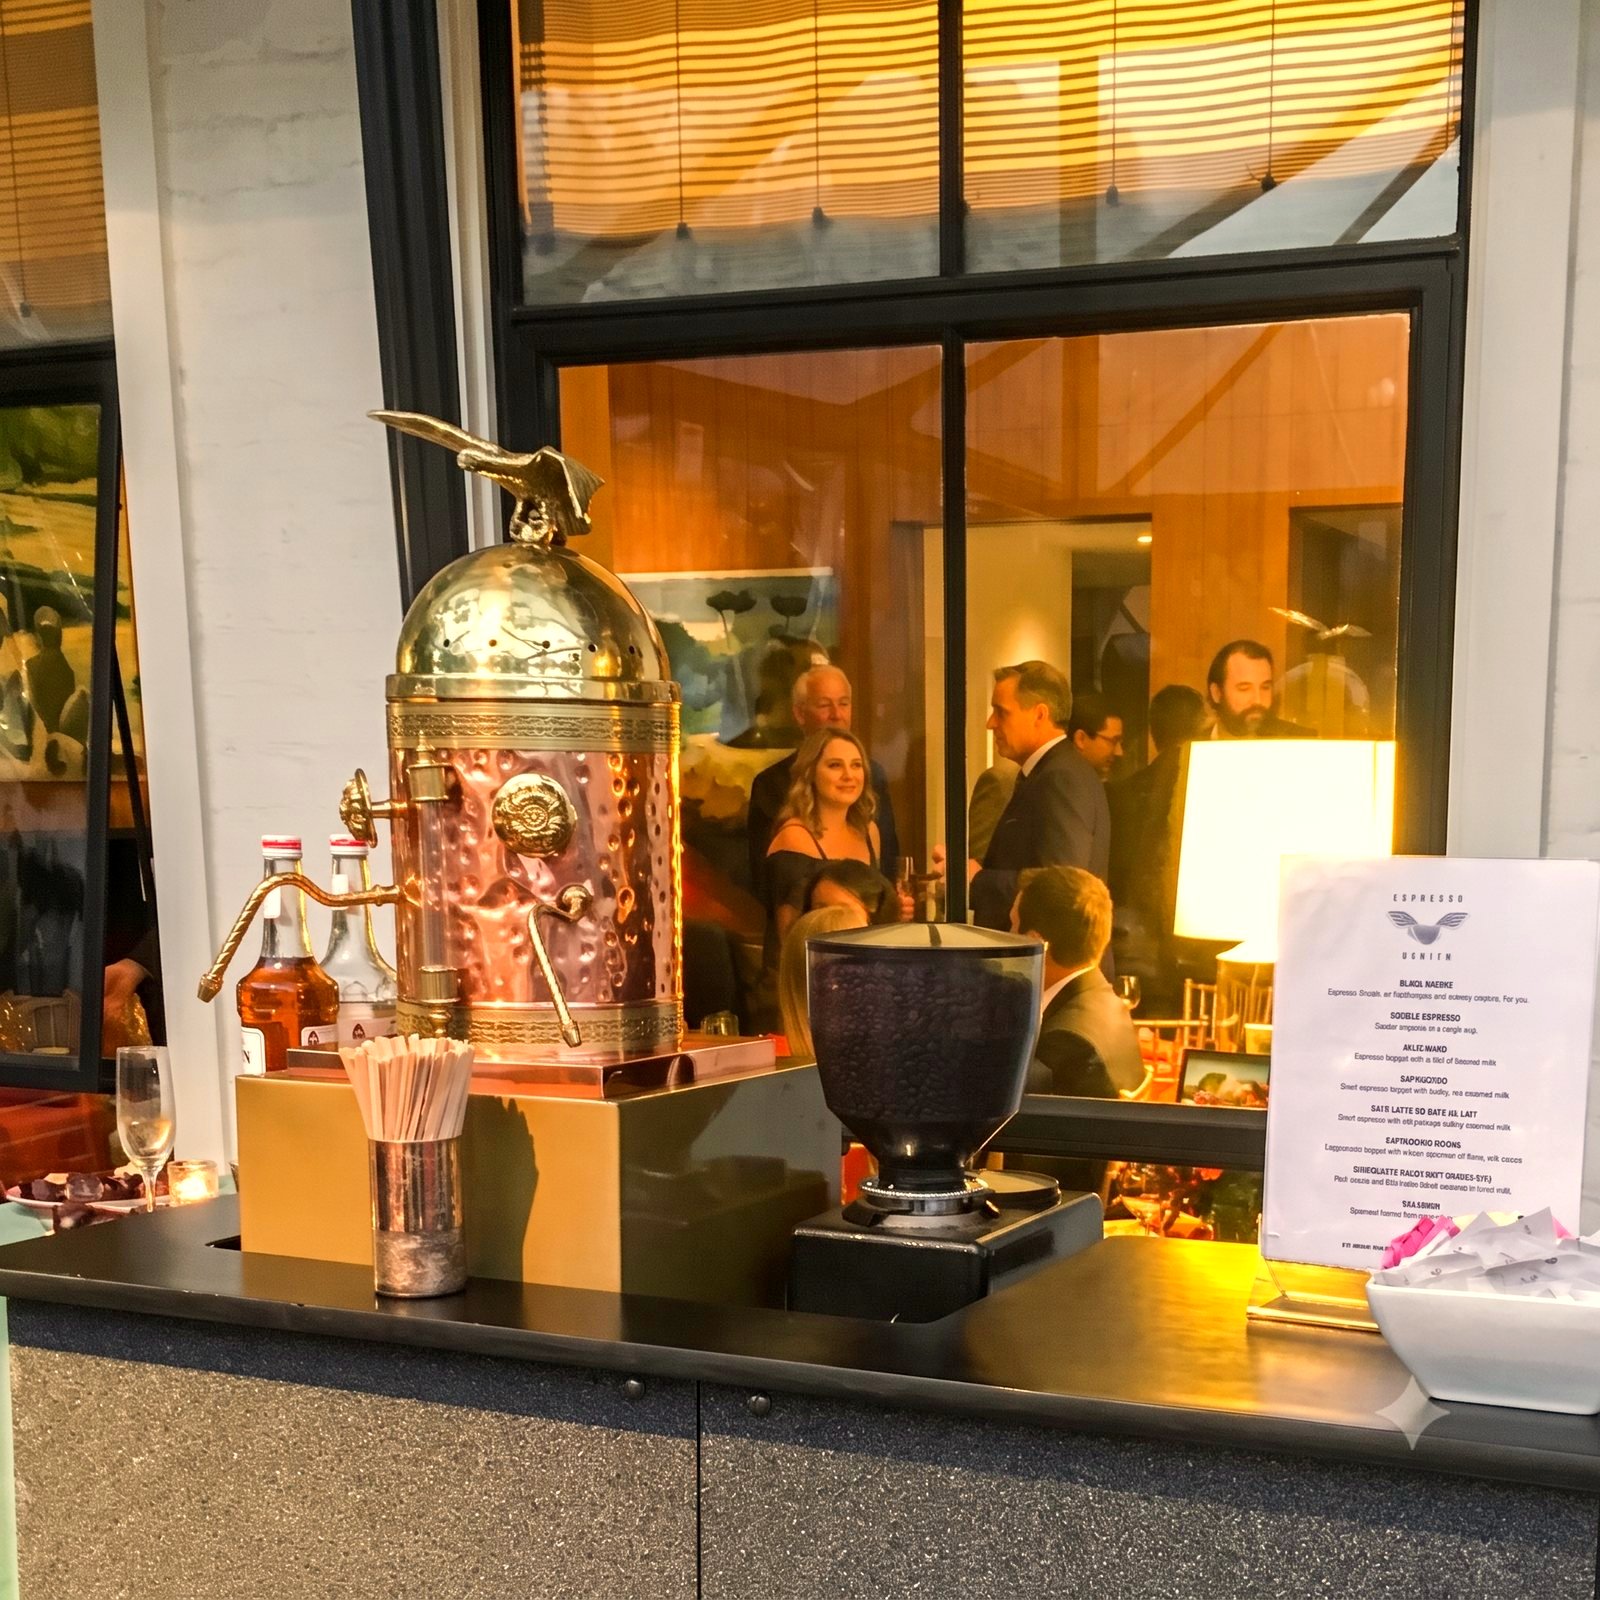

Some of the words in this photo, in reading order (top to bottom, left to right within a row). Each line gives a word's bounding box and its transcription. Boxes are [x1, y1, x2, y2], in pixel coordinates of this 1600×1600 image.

[1393, 894, 1463, 903] ESPRESSO
[1422, 1013, 1461, 1022] ESPRESSO
[1354, 1052, 1384, 1061] Espresso
[1391, 1106, 1414, 1114] LATTE
